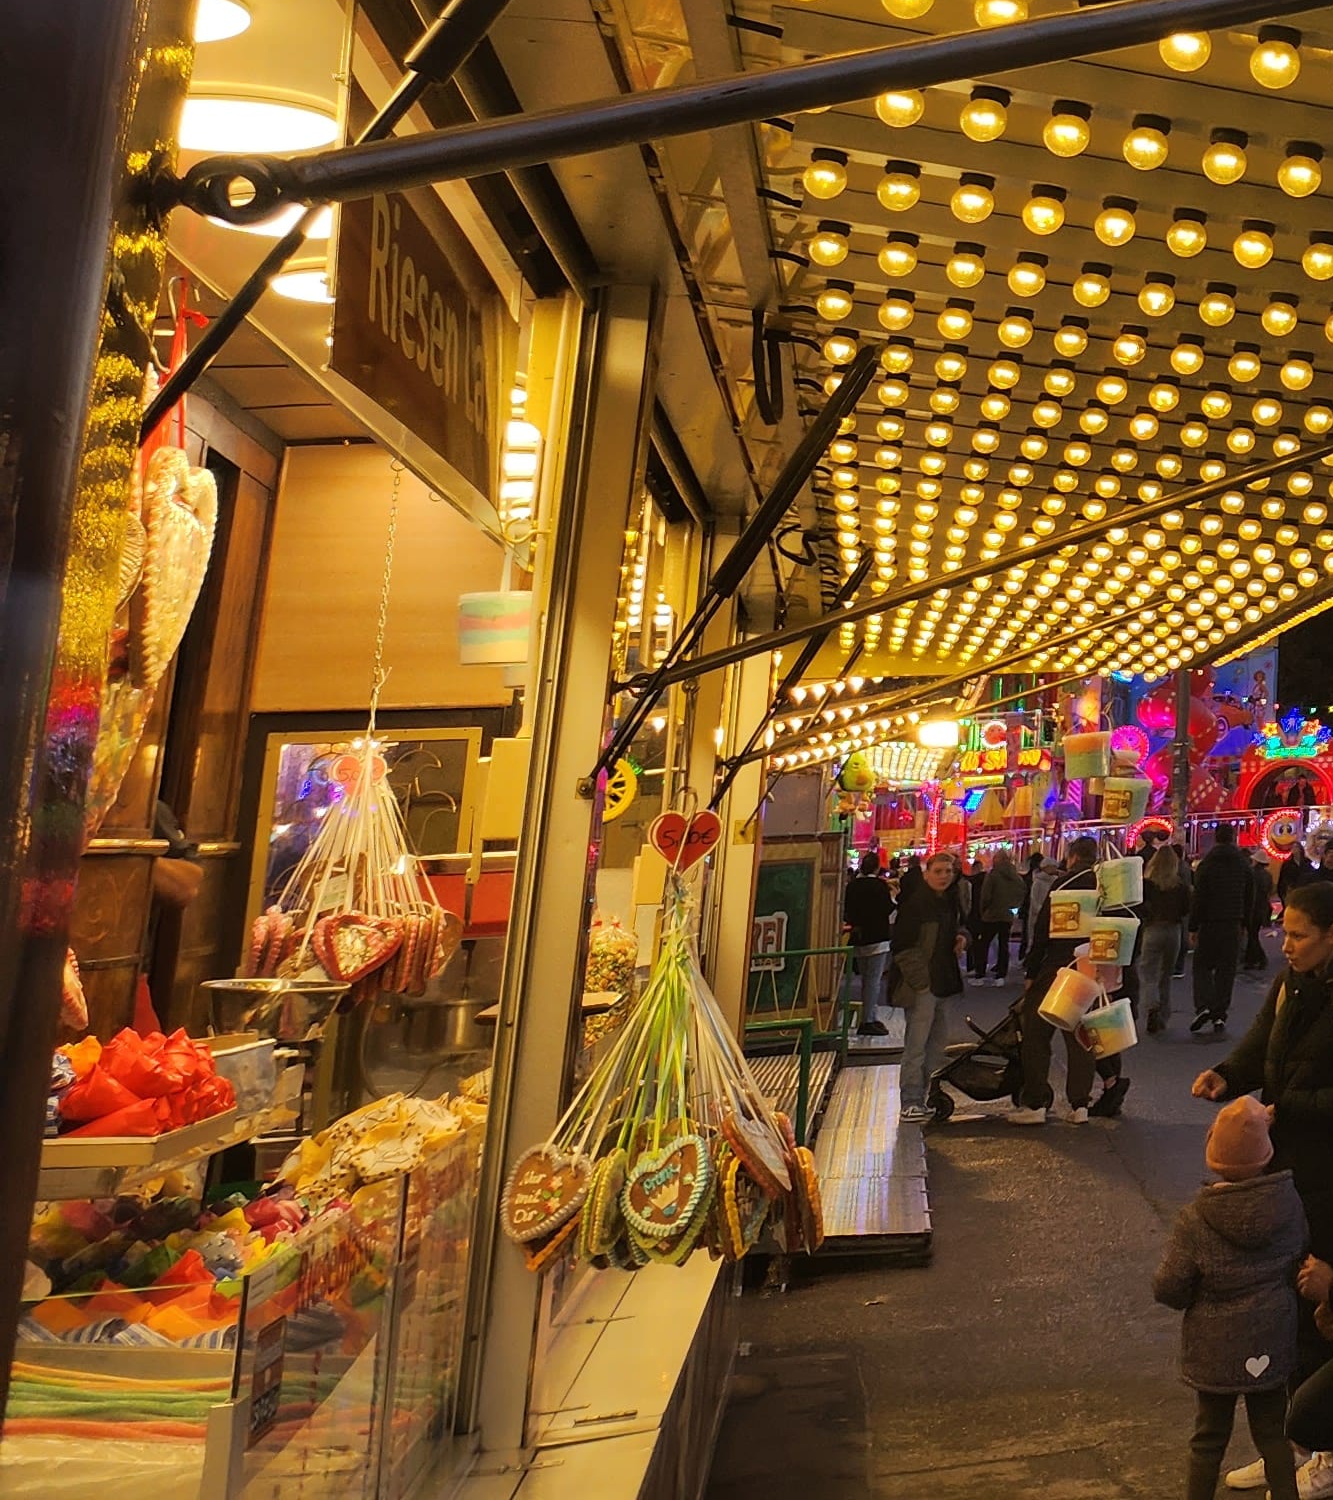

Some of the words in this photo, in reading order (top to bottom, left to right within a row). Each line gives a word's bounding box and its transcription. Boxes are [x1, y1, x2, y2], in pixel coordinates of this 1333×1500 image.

[369, 191, 459, 404] Riesen
[518, 1170, 547, 1187] Nur
[514, 1188, 542, 1205] mit
[513, 1206, 538, 1224] Dir
